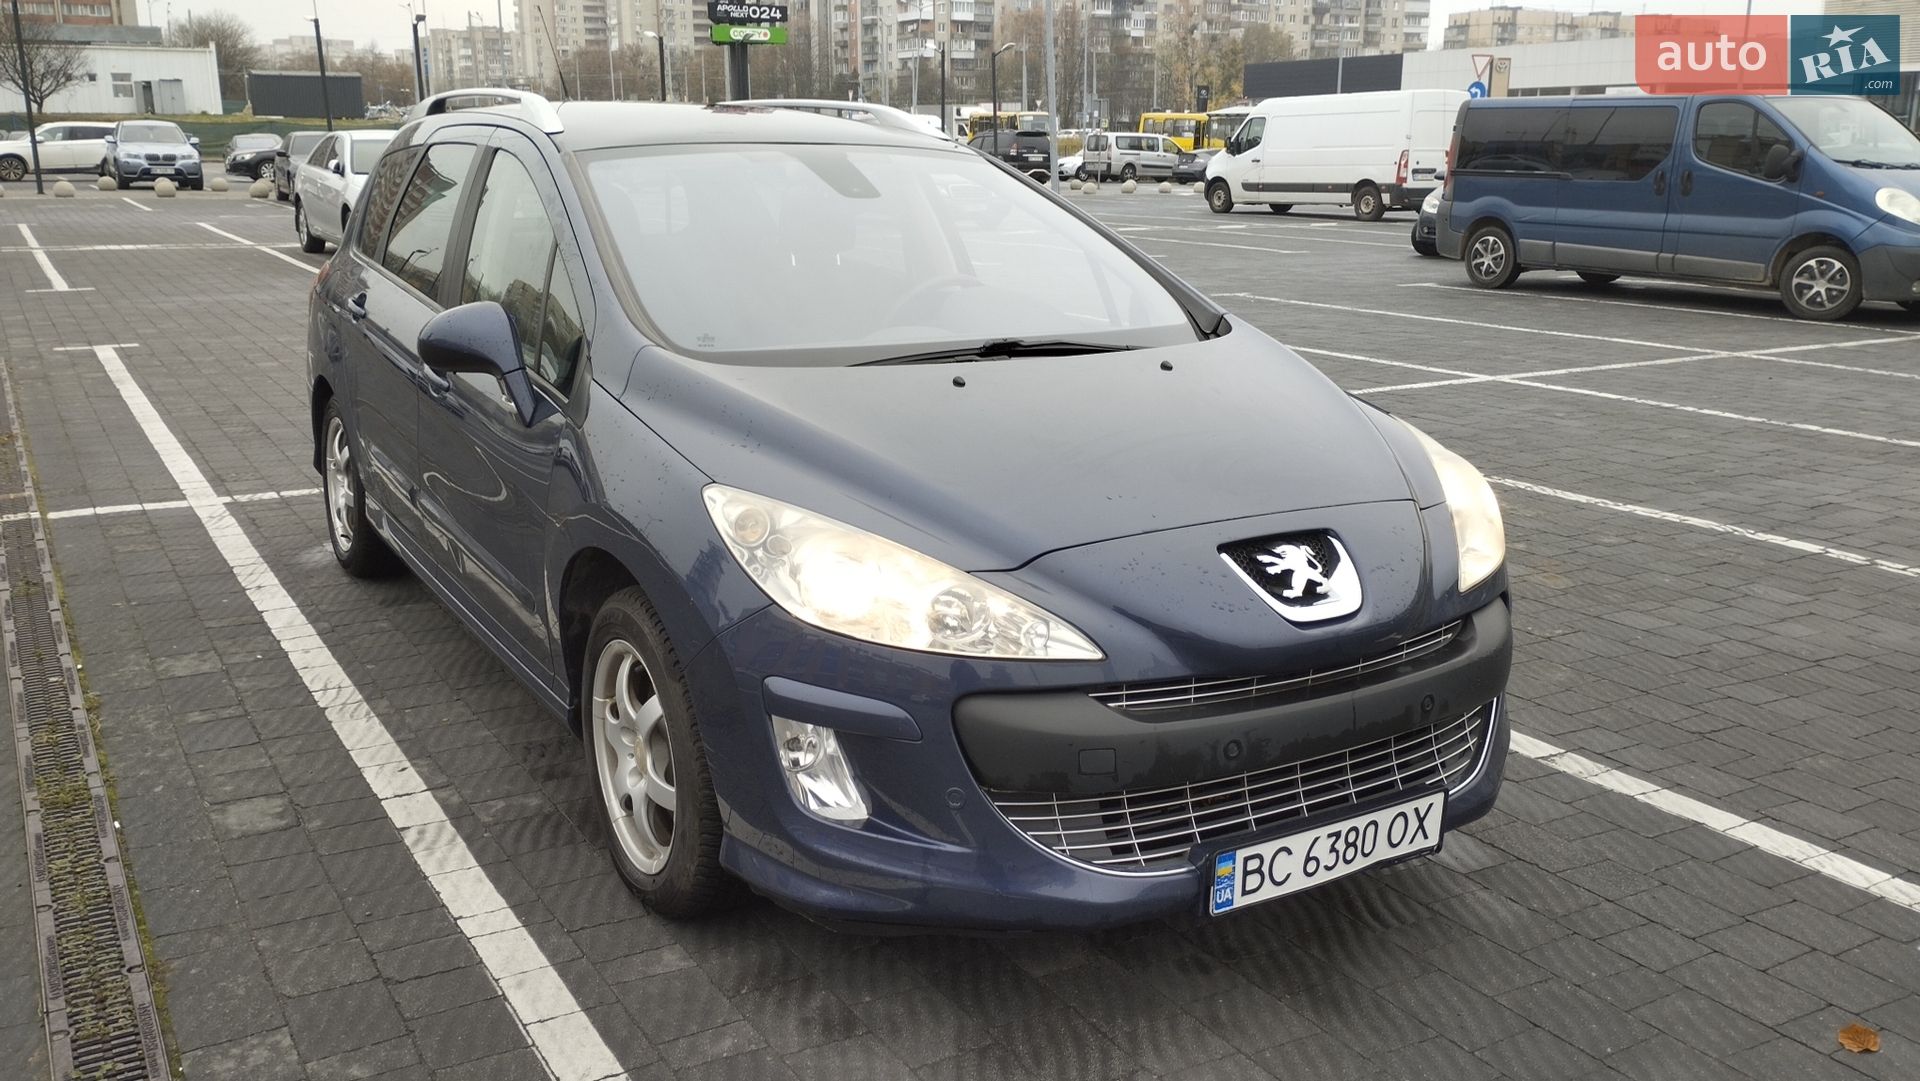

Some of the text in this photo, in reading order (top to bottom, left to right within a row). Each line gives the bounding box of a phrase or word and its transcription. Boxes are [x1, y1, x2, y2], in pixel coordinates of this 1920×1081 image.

[717, 4, 749, 12] APOLLO
[749, 6, 782, 19] 024
[1240, 802, 1435, 897] BC 6380 OX
[1216, 888, 1232, 903] UA
